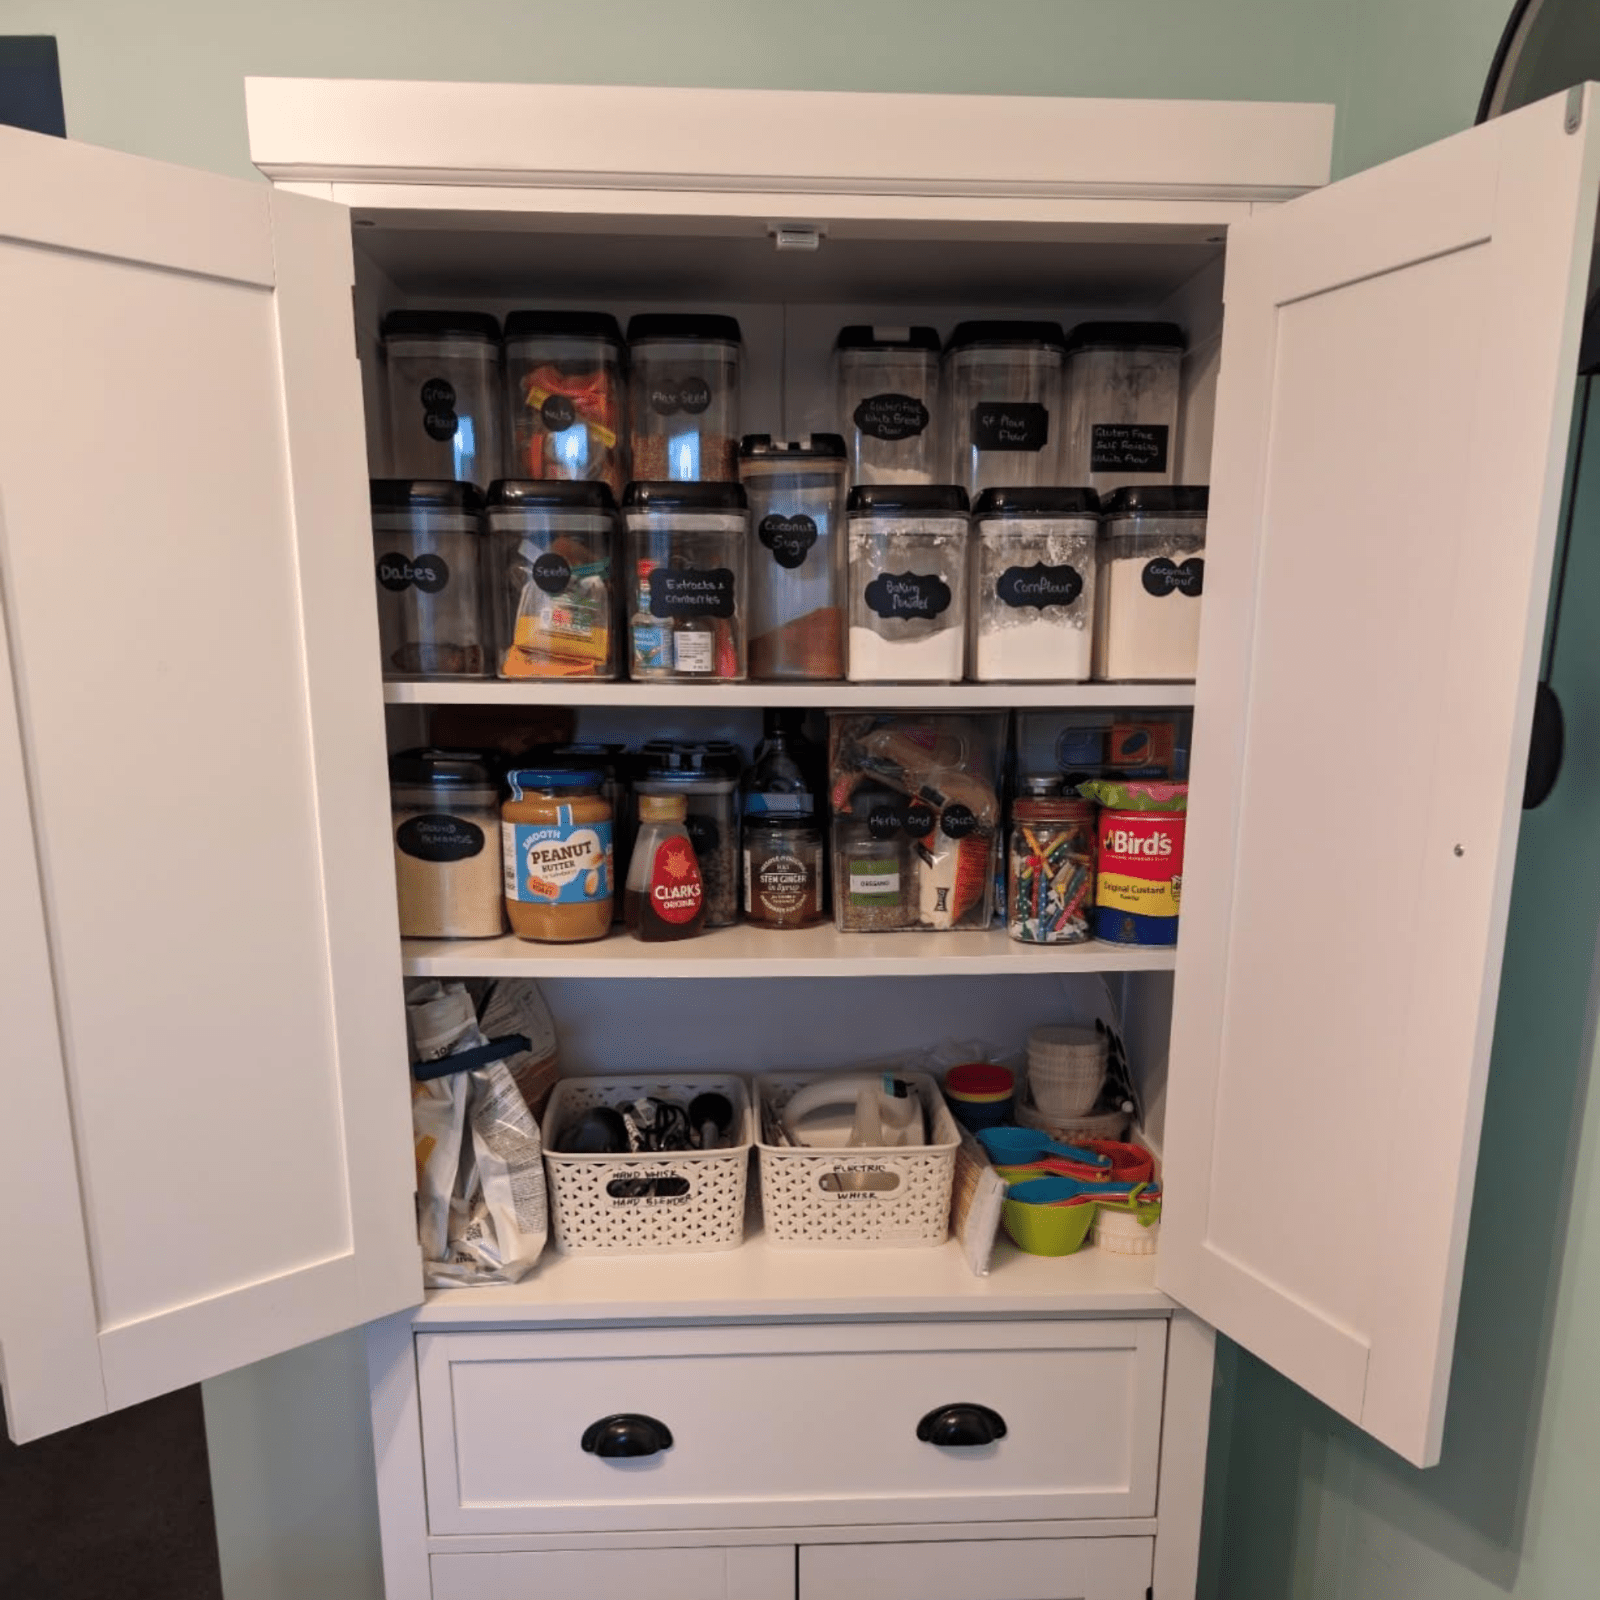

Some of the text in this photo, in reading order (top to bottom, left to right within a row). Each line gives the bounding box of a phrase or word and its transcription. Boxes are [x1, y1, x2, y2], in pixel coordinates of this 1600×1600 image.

[999, 430, 1028, 442] Flour
[1096, 428, 1154, 440] Gluten Free
[1096, 441, 1117, 451] Self
[1125, 454, 1149, 464] Flour
[764, 521, 815, 532] Coconut
[381, 564, 436, 581] Dates
[535, 566, 569, 576] Seeds
[1150, 565, 1194, 576] Coconut
[666, 579, 717, 591] Extracts
[886, 580, 920, 599] Baking
[892, 593, 929, 610] Powder
[871, 814, 901, 827] Herbs
[945, 815, 975, 829] Spices
[1114, 830, 1173, 855] Bird's
[531, 841, 592, 865] PEANUT
[542, 860, 576, 873] BUTTER
[760, 875, 807, 884] STEM GINGER
[654, 883, 701, 900] CLARKS
[1131, 884, 1165, 894] Custard
[663, 899, 697, 909] ORIGINAL
[833, 1164, 886, 1172] ELECTRIC
[613, 1169, 679, 1179] HAND WHISK
[837, 1192, 877, 1200] WHISK
[613, 1198, 640, 1206] HAND
